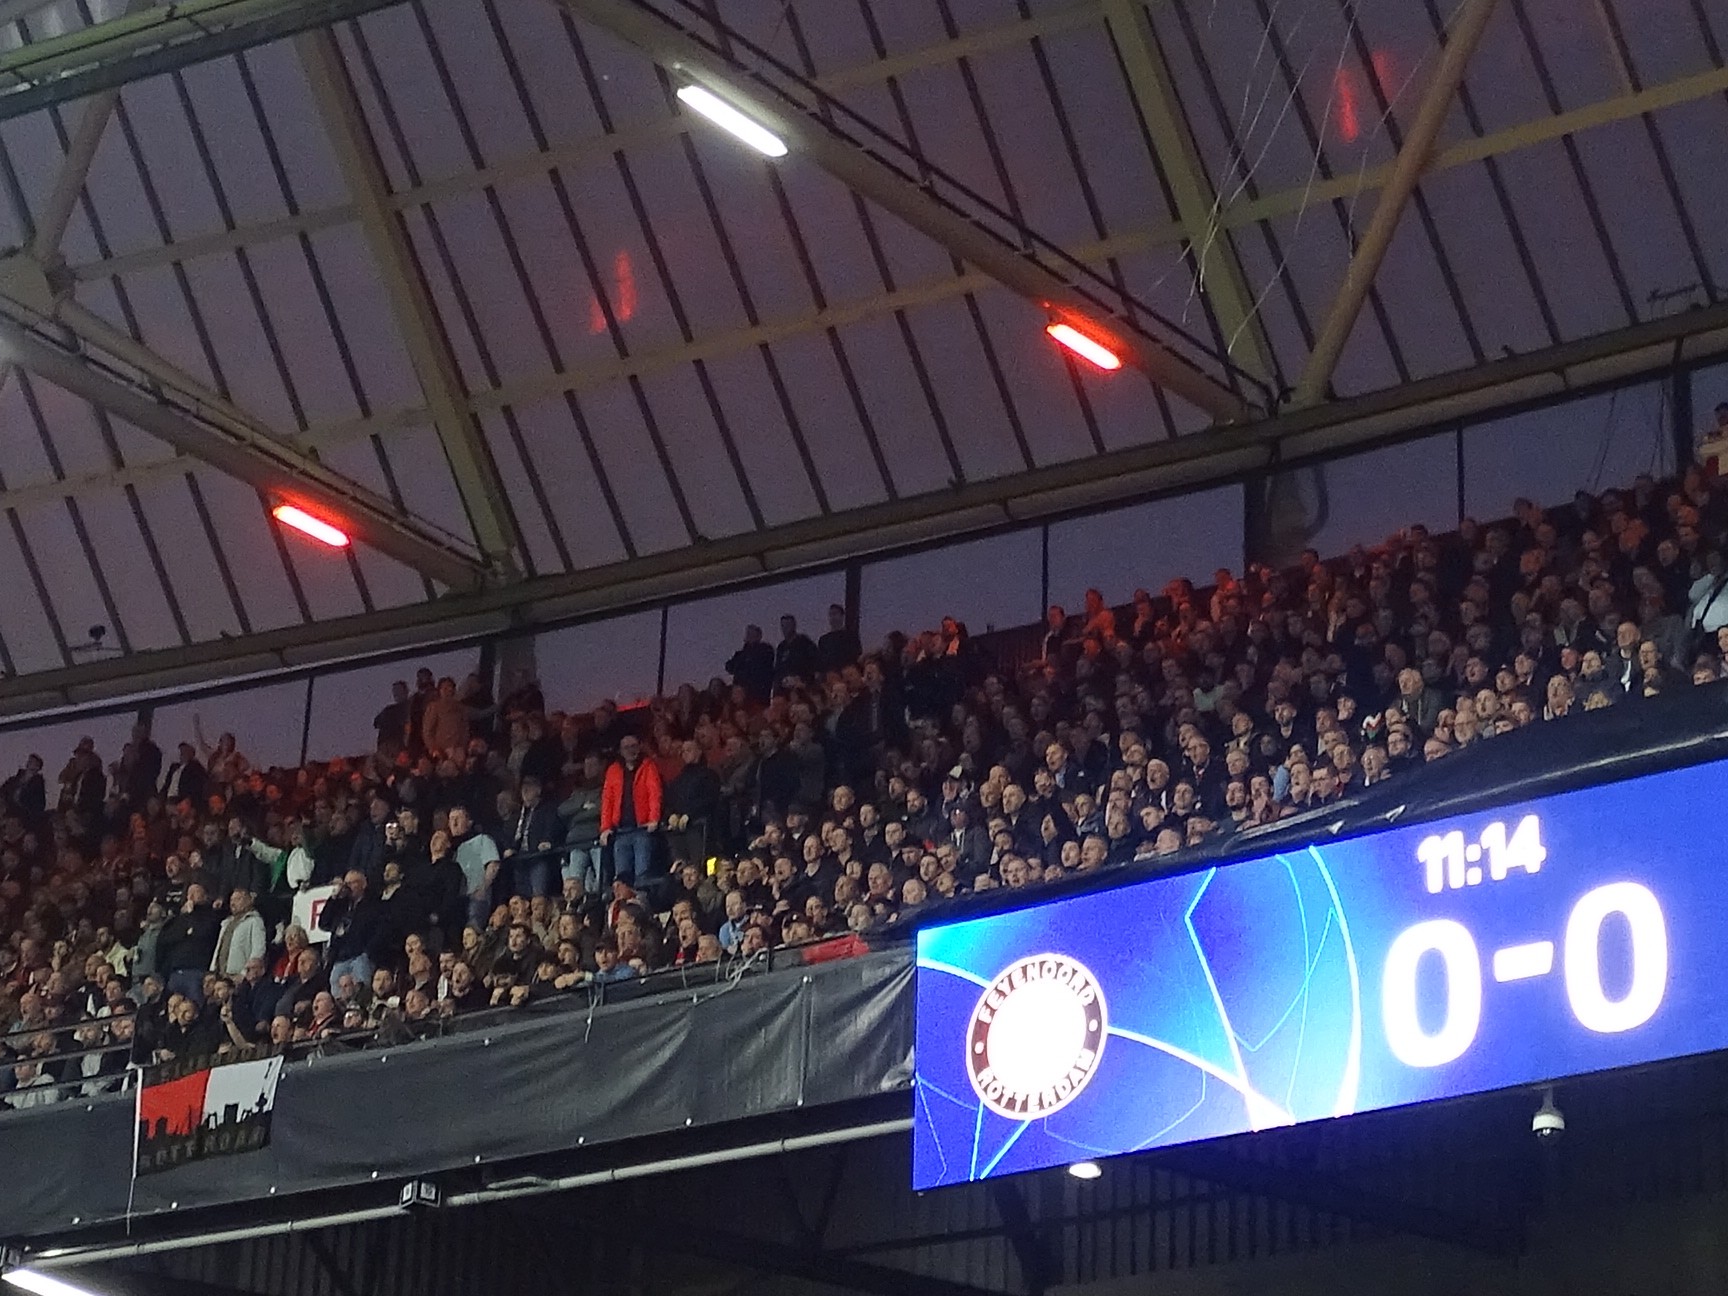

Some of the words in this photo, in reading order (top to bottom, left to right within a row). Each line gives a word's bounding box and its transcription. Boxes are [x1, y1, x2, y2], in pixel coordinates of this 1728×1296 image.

[1417, 814, 1547, 894] 11:14
[977, 960, 1096, 1025] FEYENOORD
[1381, 881, 1668, 1068] 0-0
